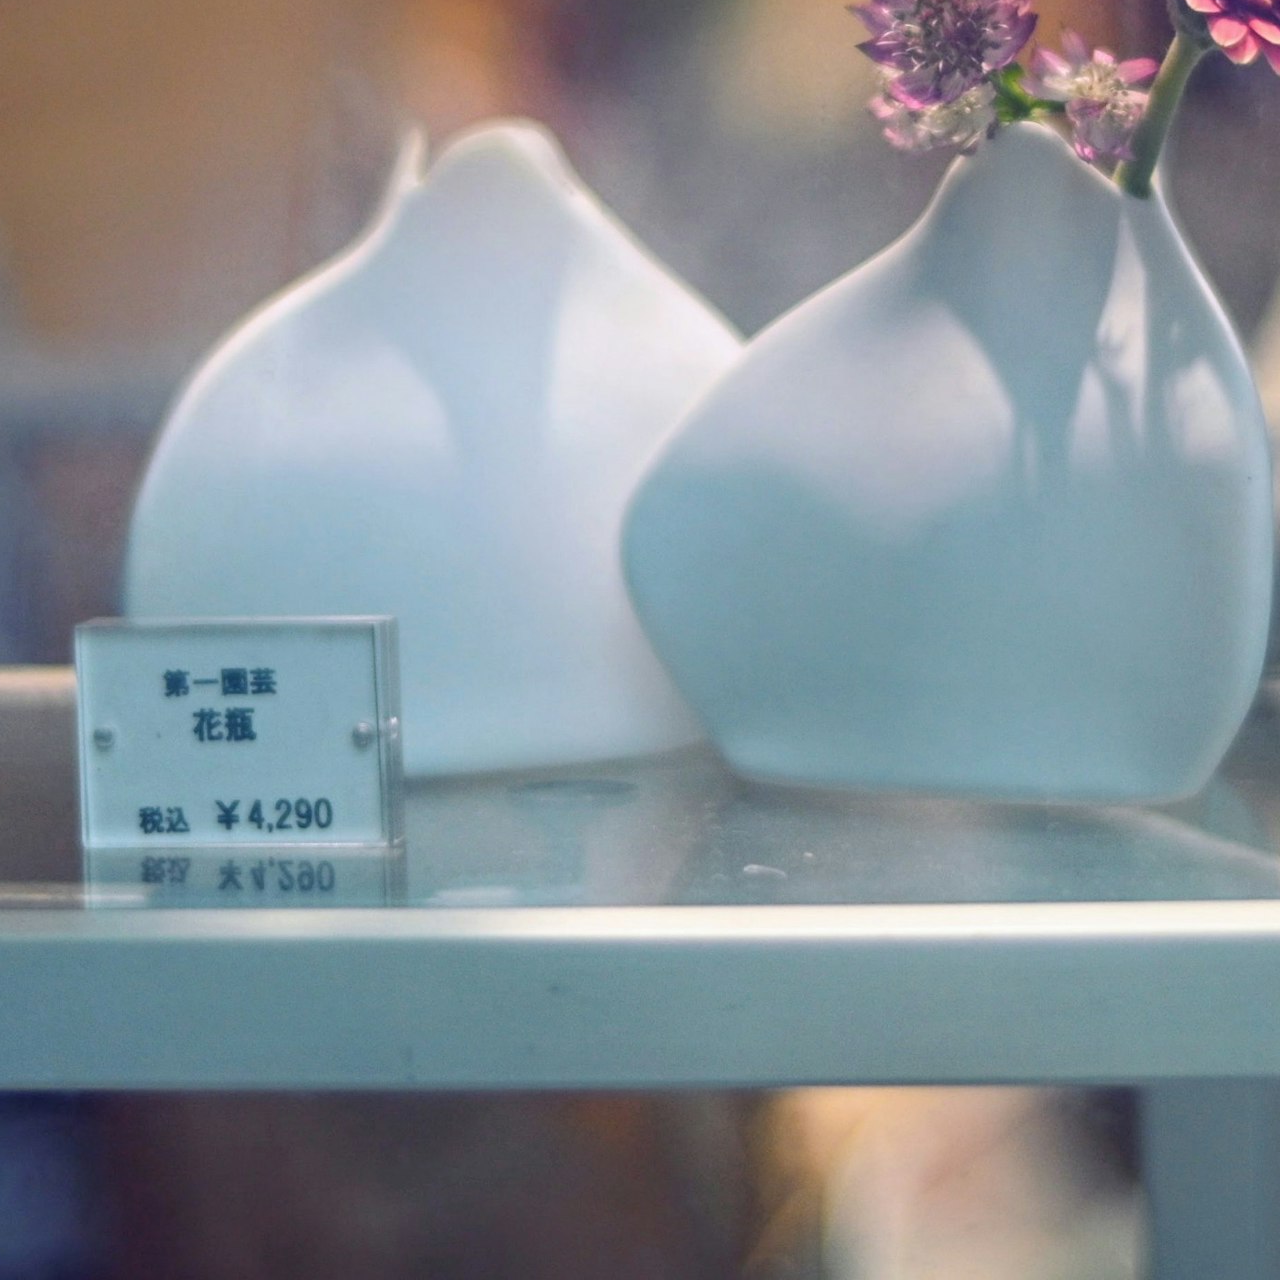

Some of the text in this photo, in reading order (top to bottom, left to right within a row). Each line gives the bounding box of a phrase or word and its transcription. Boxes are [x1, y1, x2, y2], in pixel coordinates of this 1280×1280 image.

[163, 668, 277, 697] 第一園芸
[193, 707, 257, 742] 花瓶
[139, 797, 334, 834] 税込 ¥4,290
